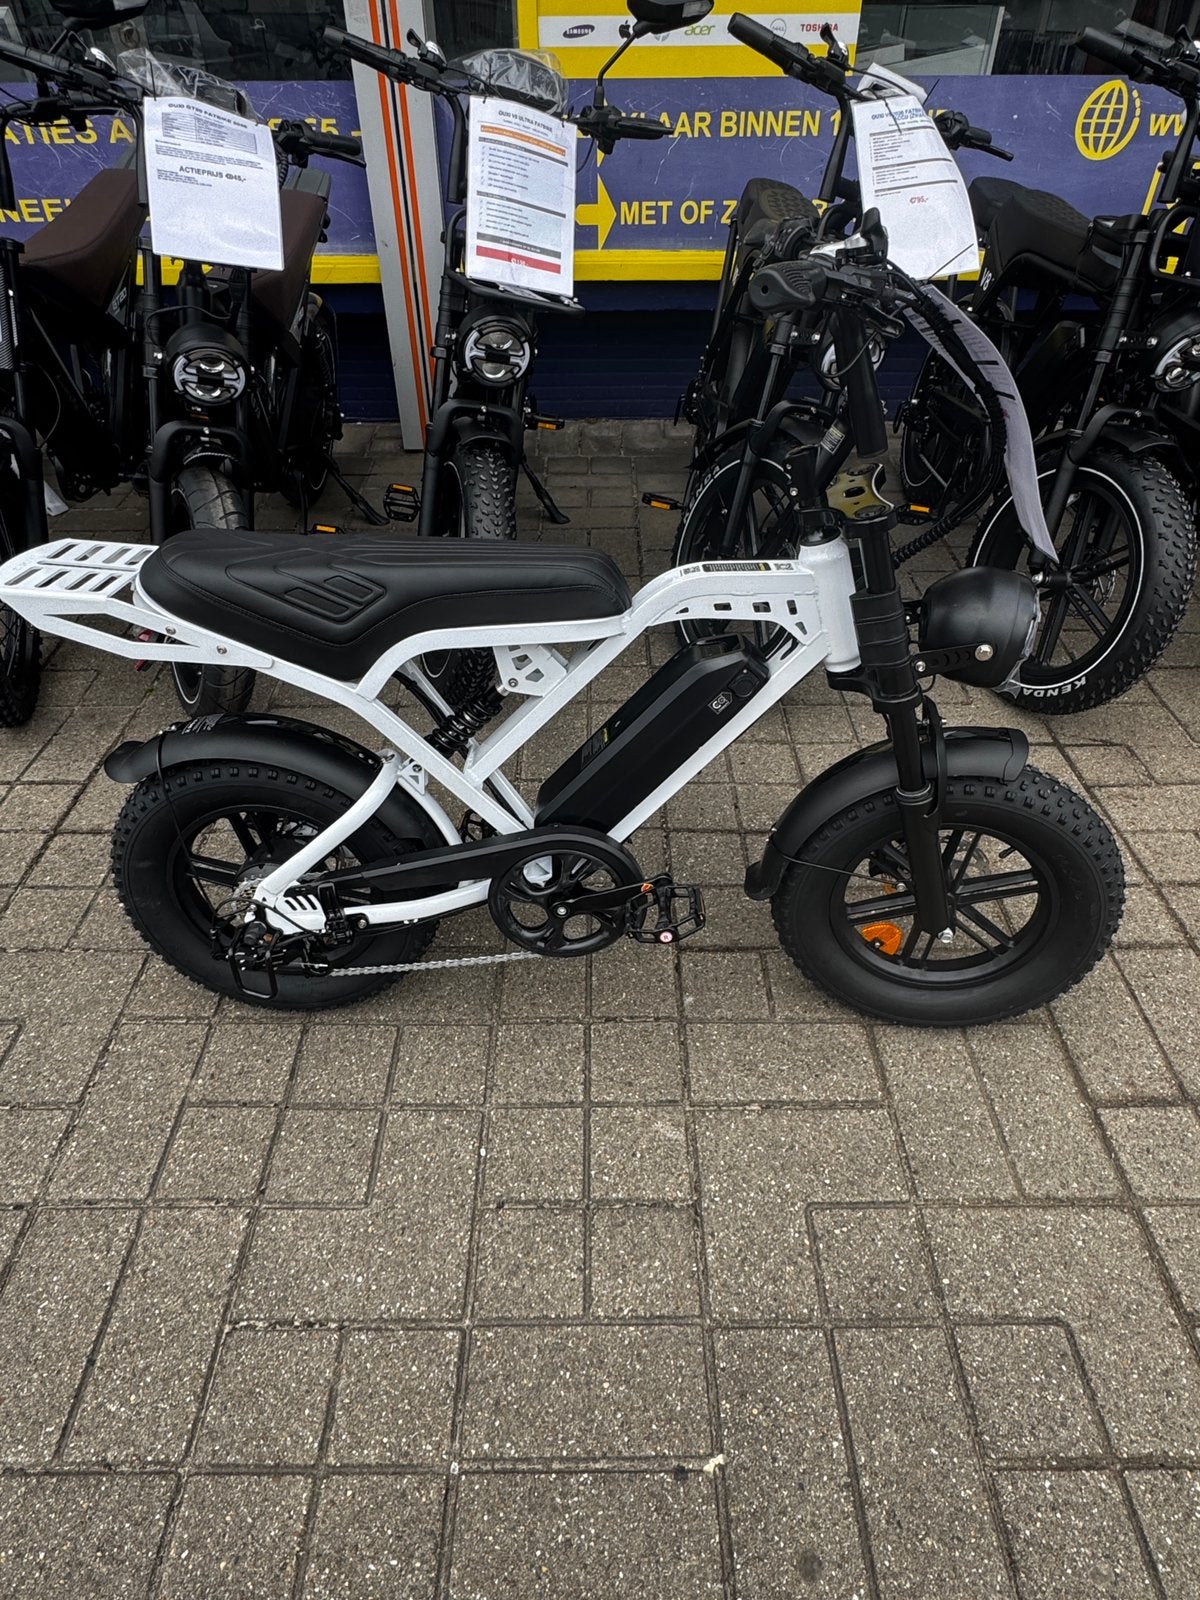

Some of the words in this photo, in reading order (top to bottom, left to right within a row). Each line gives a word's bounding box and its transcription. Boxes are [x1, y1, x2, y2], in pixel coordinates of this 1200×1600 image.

[684, 26, 715, 36] acer
[800, 23, 838, 32] TOSHBA
[720, 110, 820, 137] BINNEN
[620, 201, 673, 225] MET
[679, 200, 715, 225] OF
[1022, 675, 1087, 698] KENDA
